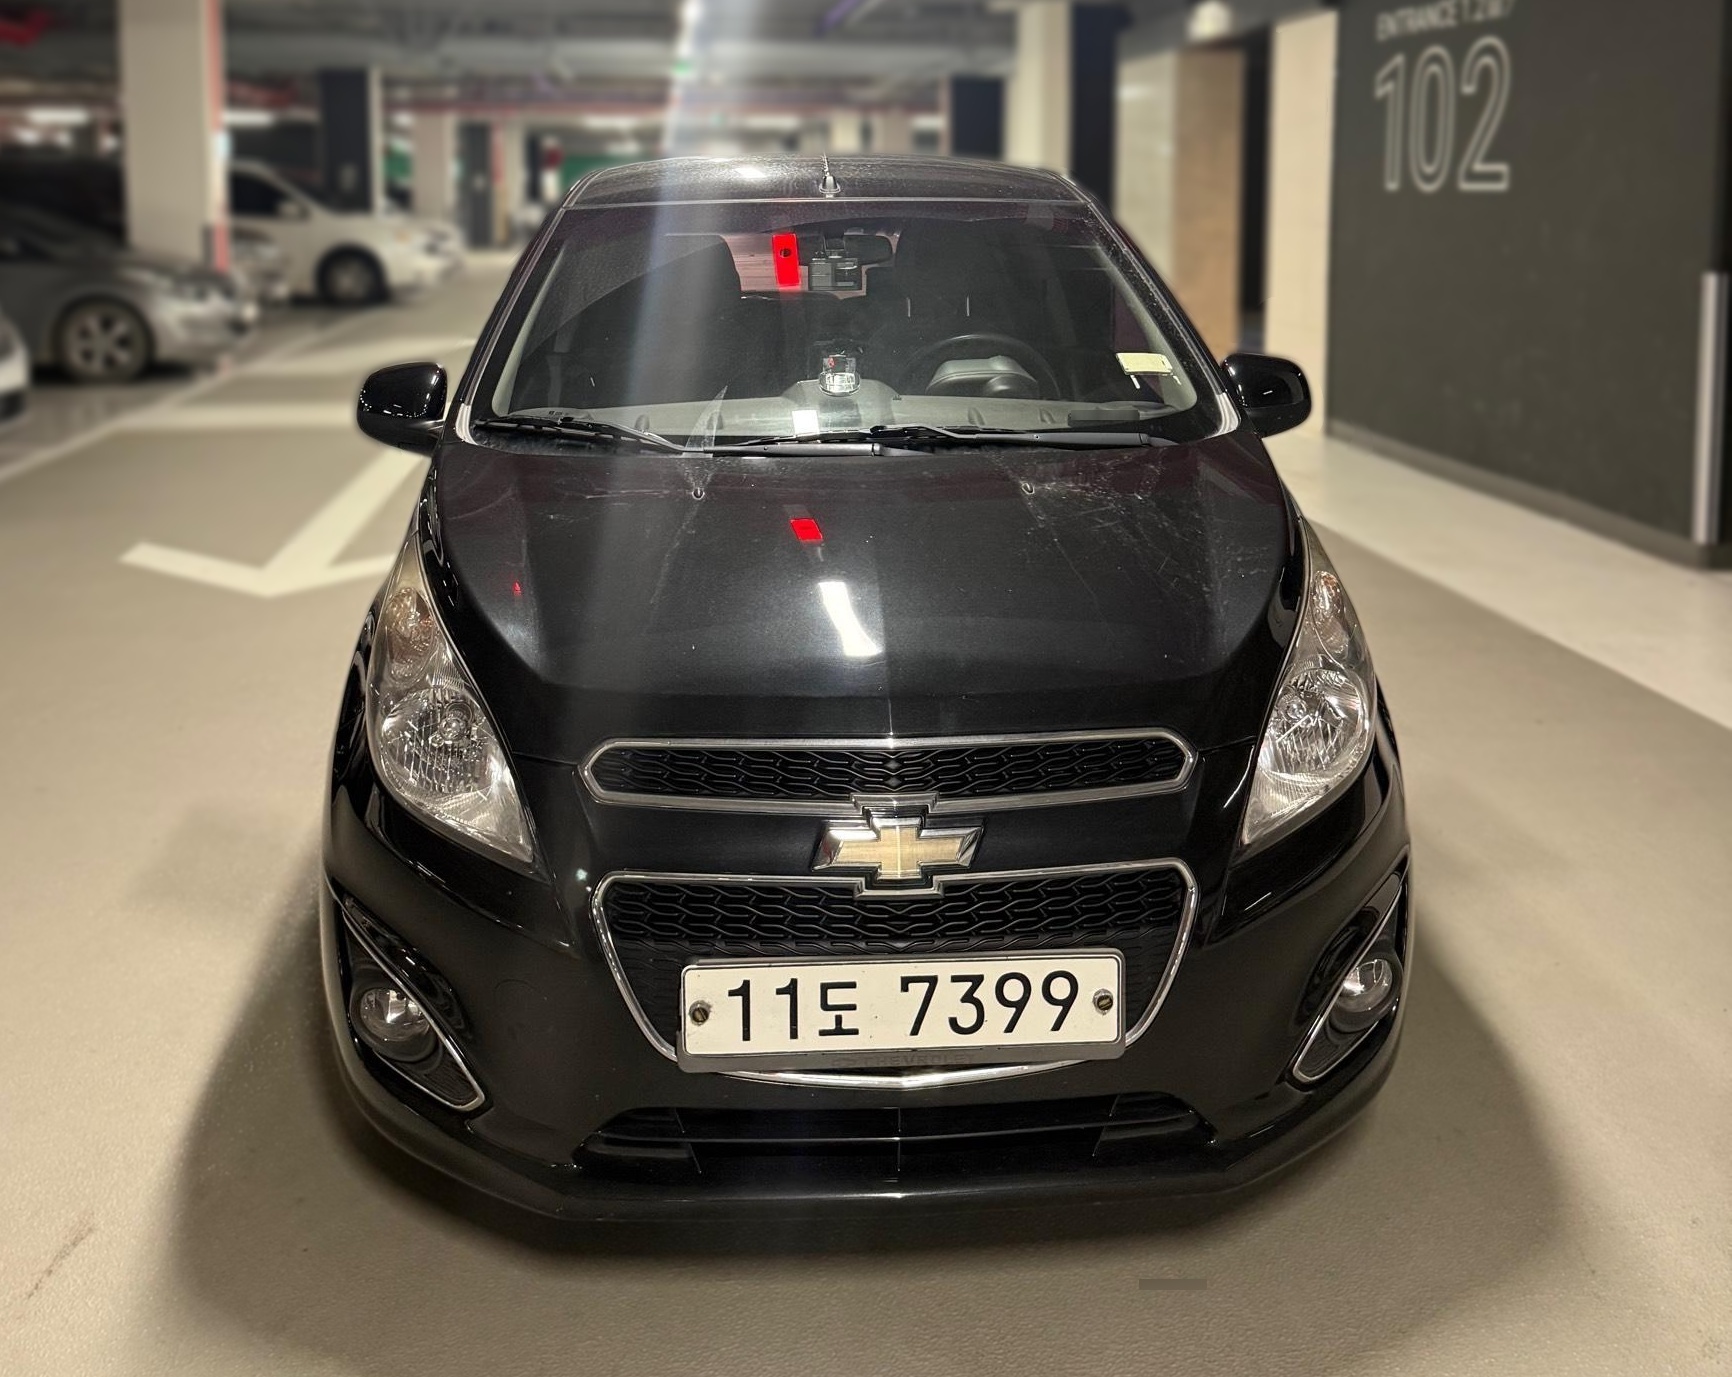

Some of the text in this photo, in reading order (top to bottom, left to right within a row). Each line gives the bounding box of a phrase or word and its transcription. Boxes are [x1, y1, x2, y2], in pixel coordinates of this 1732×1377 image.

[1374, 35, 1511, 192] 102
[728, 971, 1078, 1041] 11도 7399
